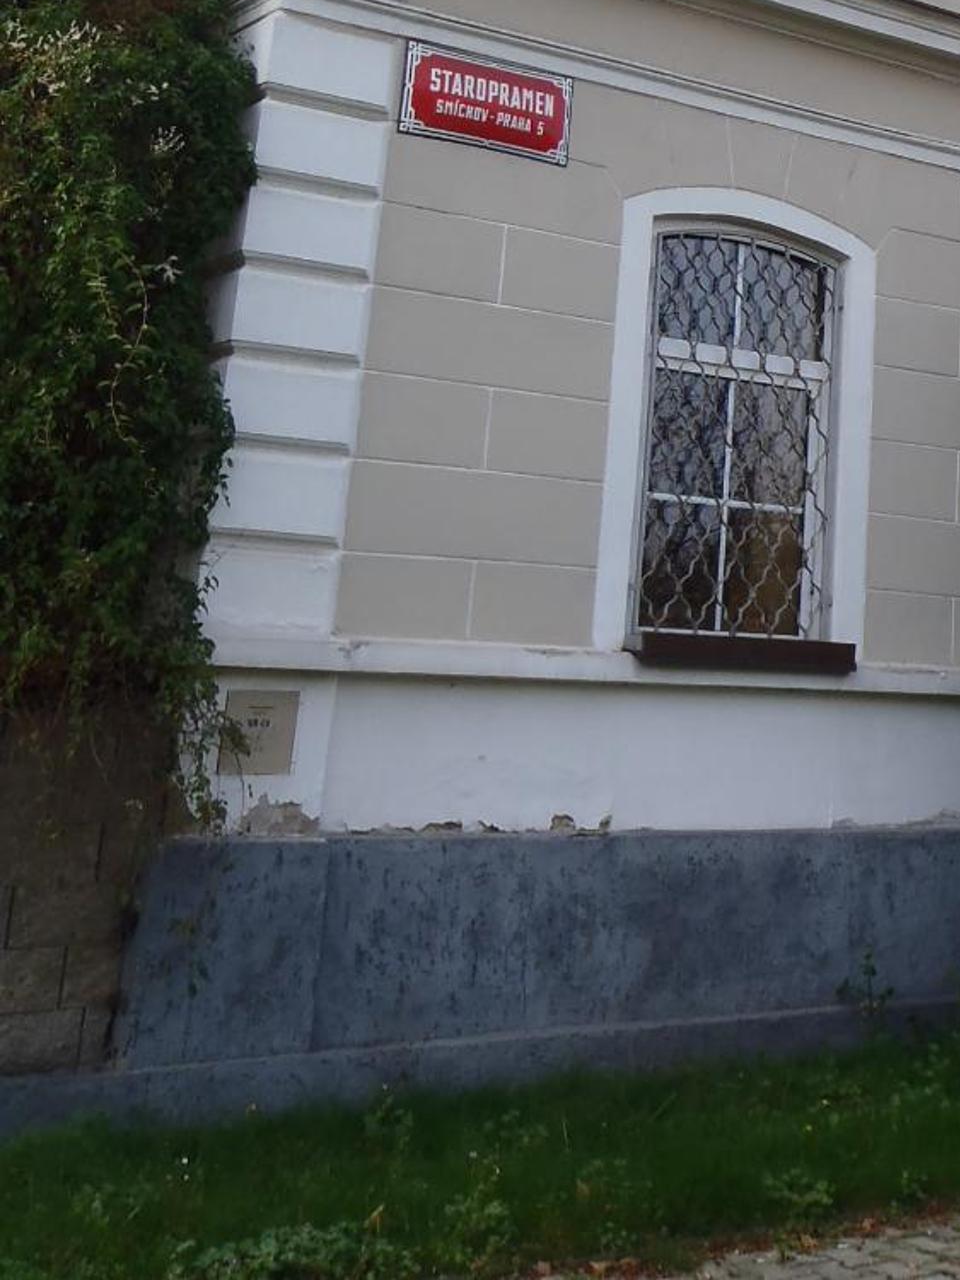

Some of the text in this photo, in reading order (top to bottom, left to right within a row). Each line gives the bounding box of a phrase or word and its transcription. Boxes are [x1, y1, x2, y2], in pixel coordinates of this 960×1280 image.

[429, 68, 556, 117] STAROPRAMEN
[435, 98, 490, 122] SMÍCHOV
[496, 111, 532, 132] PRAHA
[536, 121, 546, 136] 5
